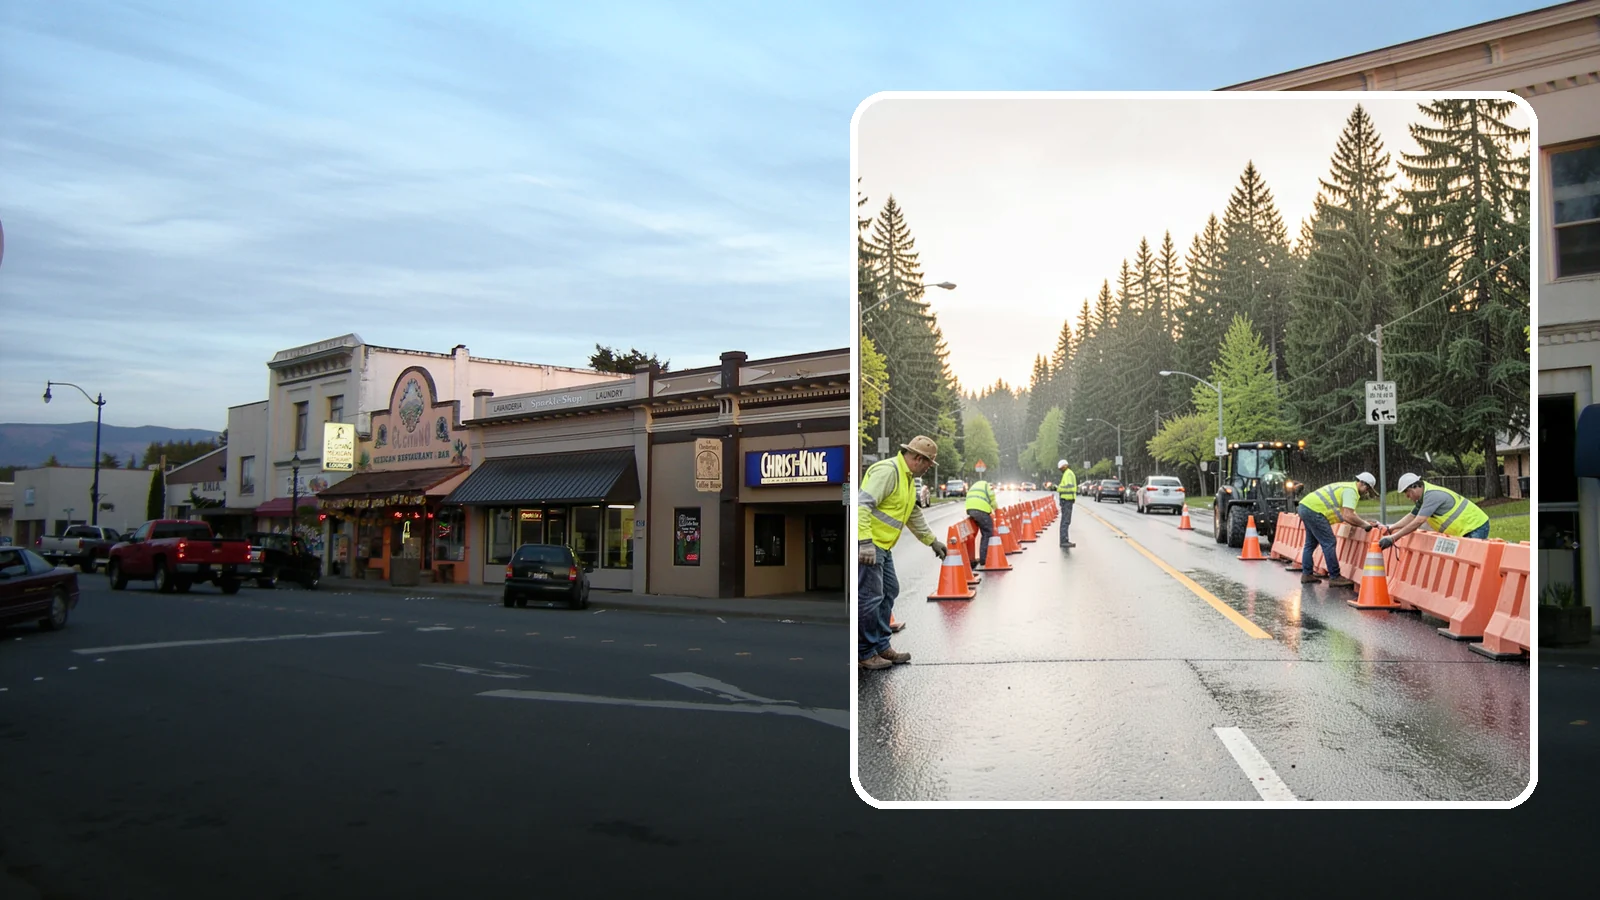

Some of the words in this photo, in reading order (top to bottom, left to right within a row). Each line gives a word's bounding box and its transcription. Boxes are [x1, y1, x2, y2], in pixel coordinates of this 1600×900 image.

[531, 397, 561, 408] Sparkle
[562, 394, 582, 406] Shop
[596, 389, 623, 400] LAUNDRY
[494, 402, 522, 412] LAVANDERIA
[373, 455, 396, 464] MEXICAN
[397, 451, 433, 462] RESTAURANT
[438, 450, 450, 459] BAR
[761, 452, 797, 478] CHRIST
[799, 450, 827, 476] KING
